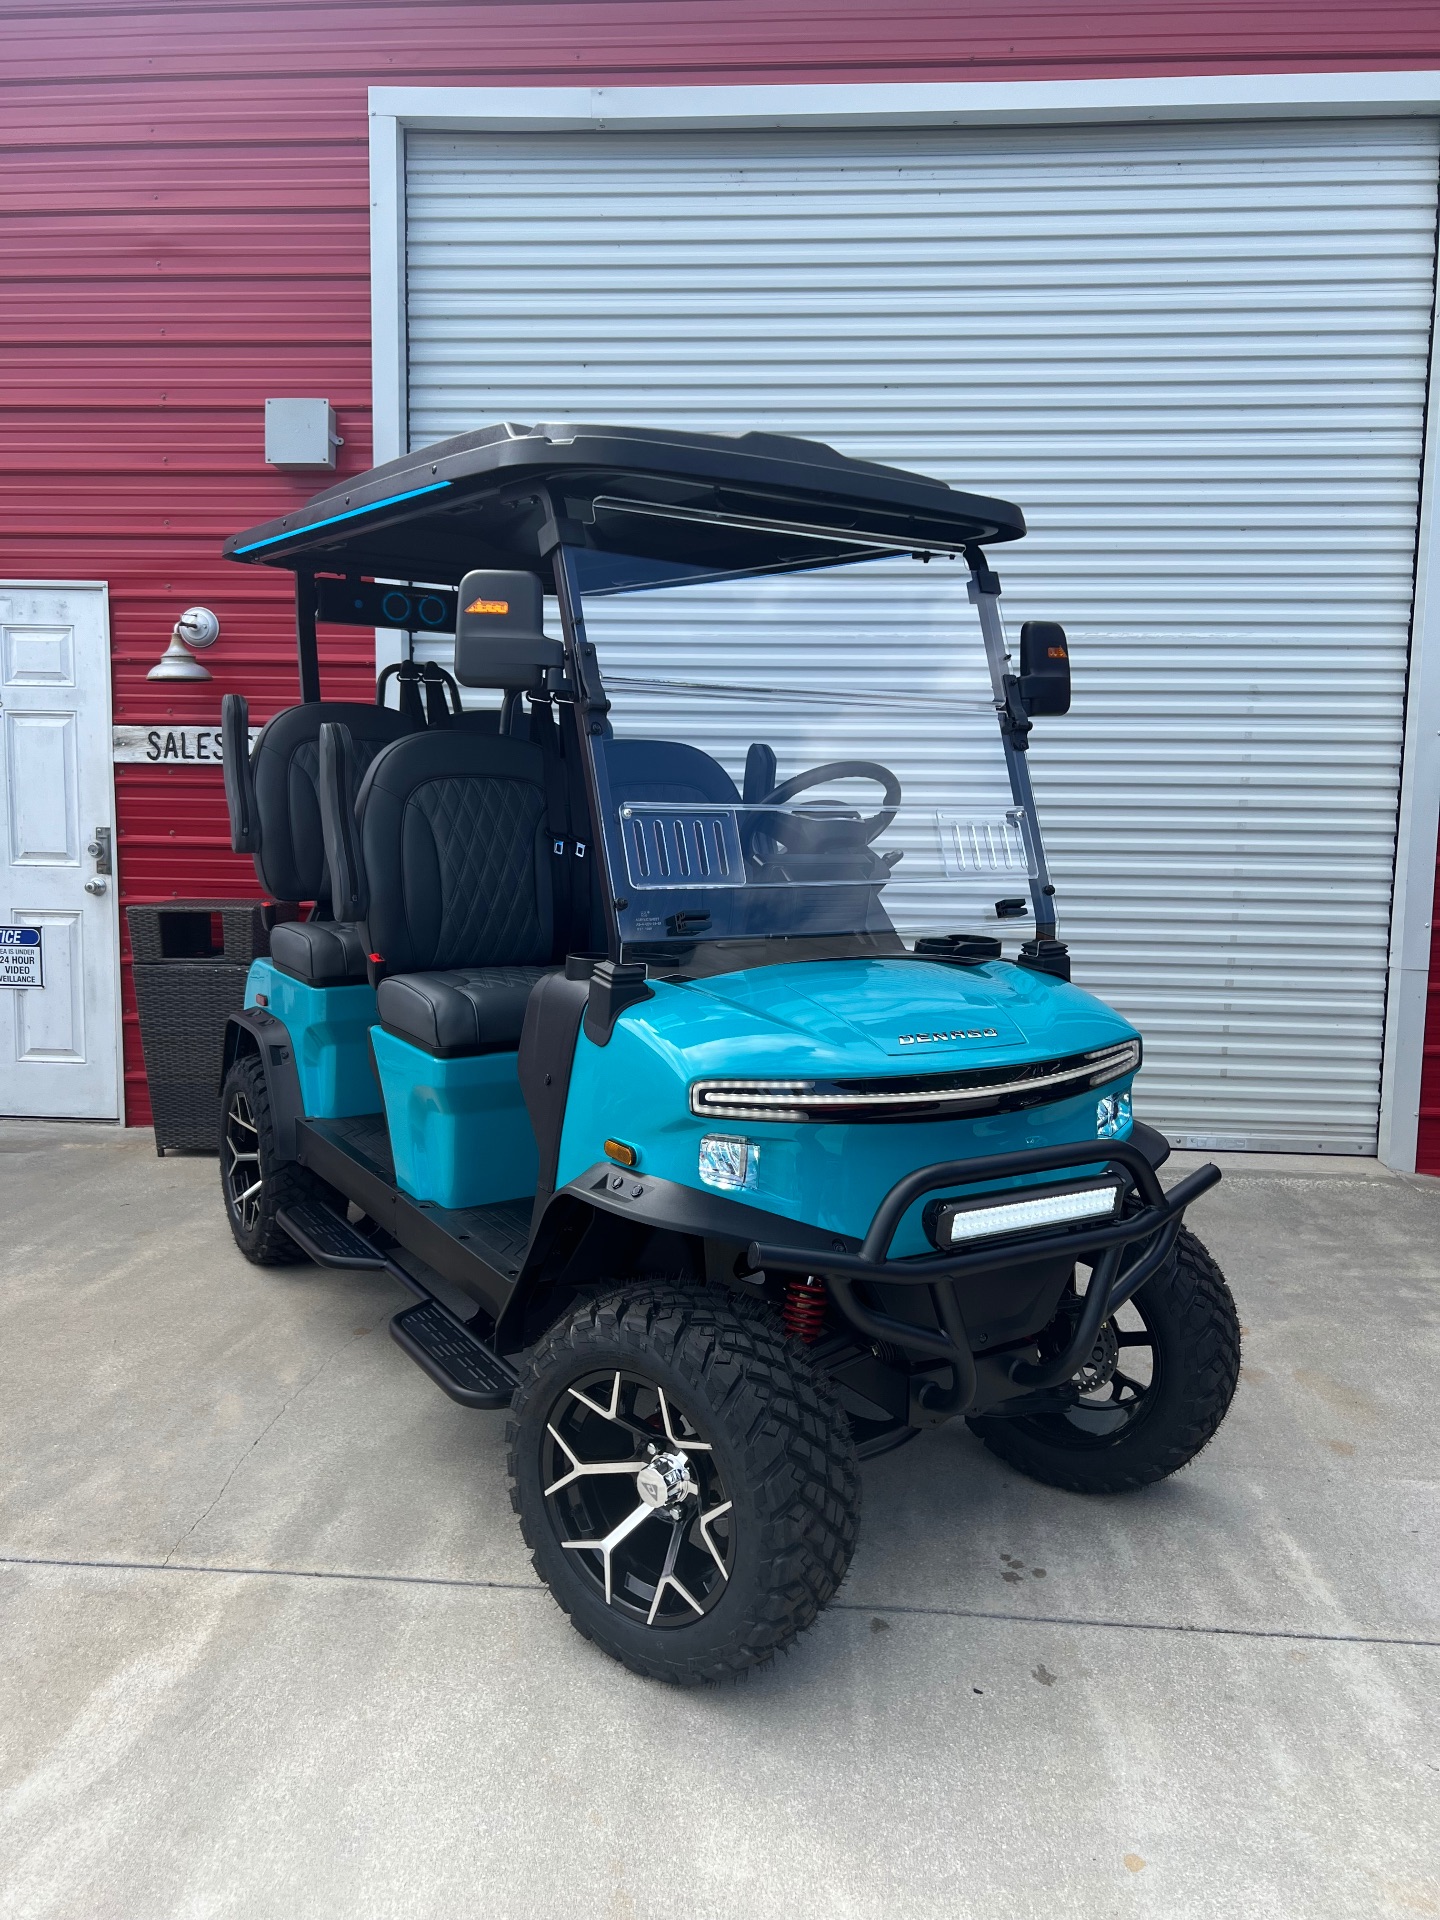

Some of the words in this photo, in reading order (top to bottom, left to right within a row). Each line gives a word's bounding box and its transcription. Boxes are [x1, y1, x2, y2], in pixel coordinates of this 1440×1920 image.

[146, 731, 223, 761] SALES
[0, 956, 10, 964] 24
[12, 956, 35, 965] HOUR
[5, 965, 30, 975] VIDEO
[899, 1028, 998, 1045] DENAGO
